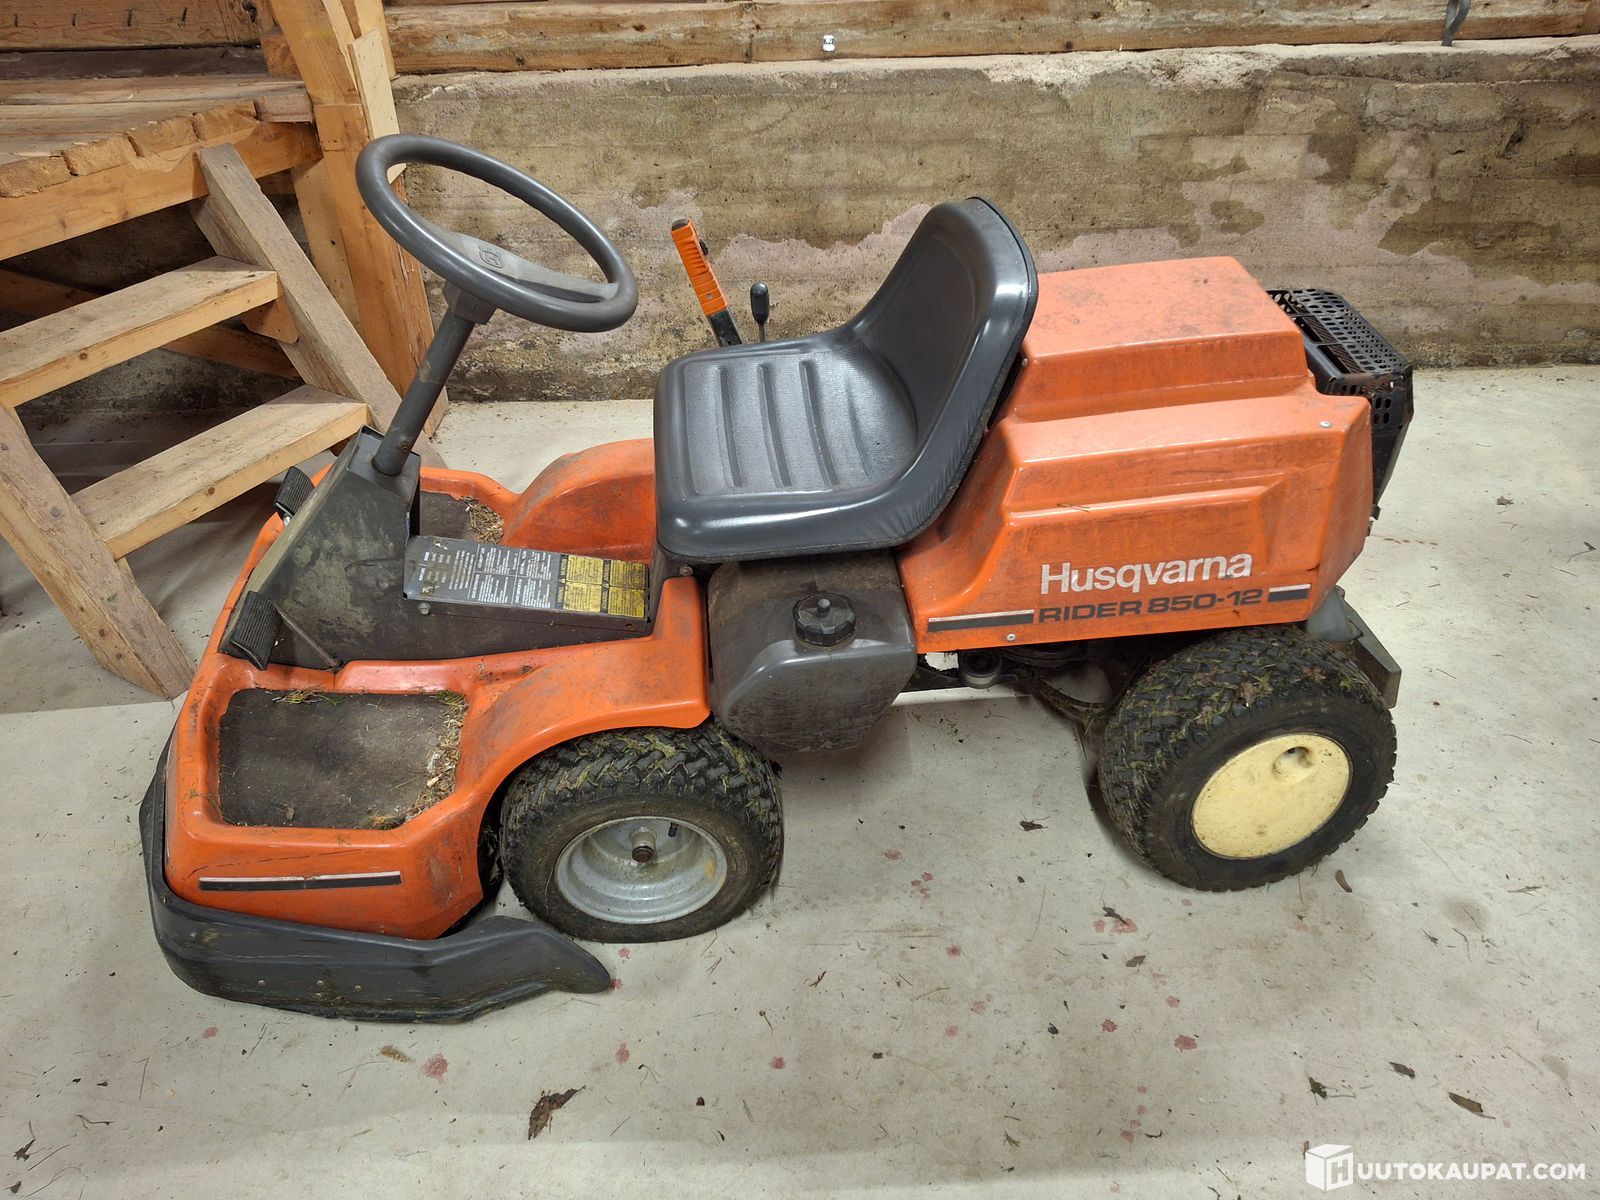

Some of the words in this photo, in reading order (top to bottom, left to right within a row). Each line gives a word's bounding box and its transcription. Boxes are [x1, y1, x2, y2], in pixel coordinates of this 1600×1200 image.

[1040, 553, 1253, 595] Husqvarna
[1038, 601, 1142, 624] RIDER
[1147, 588, 1264, 614] 850-12
